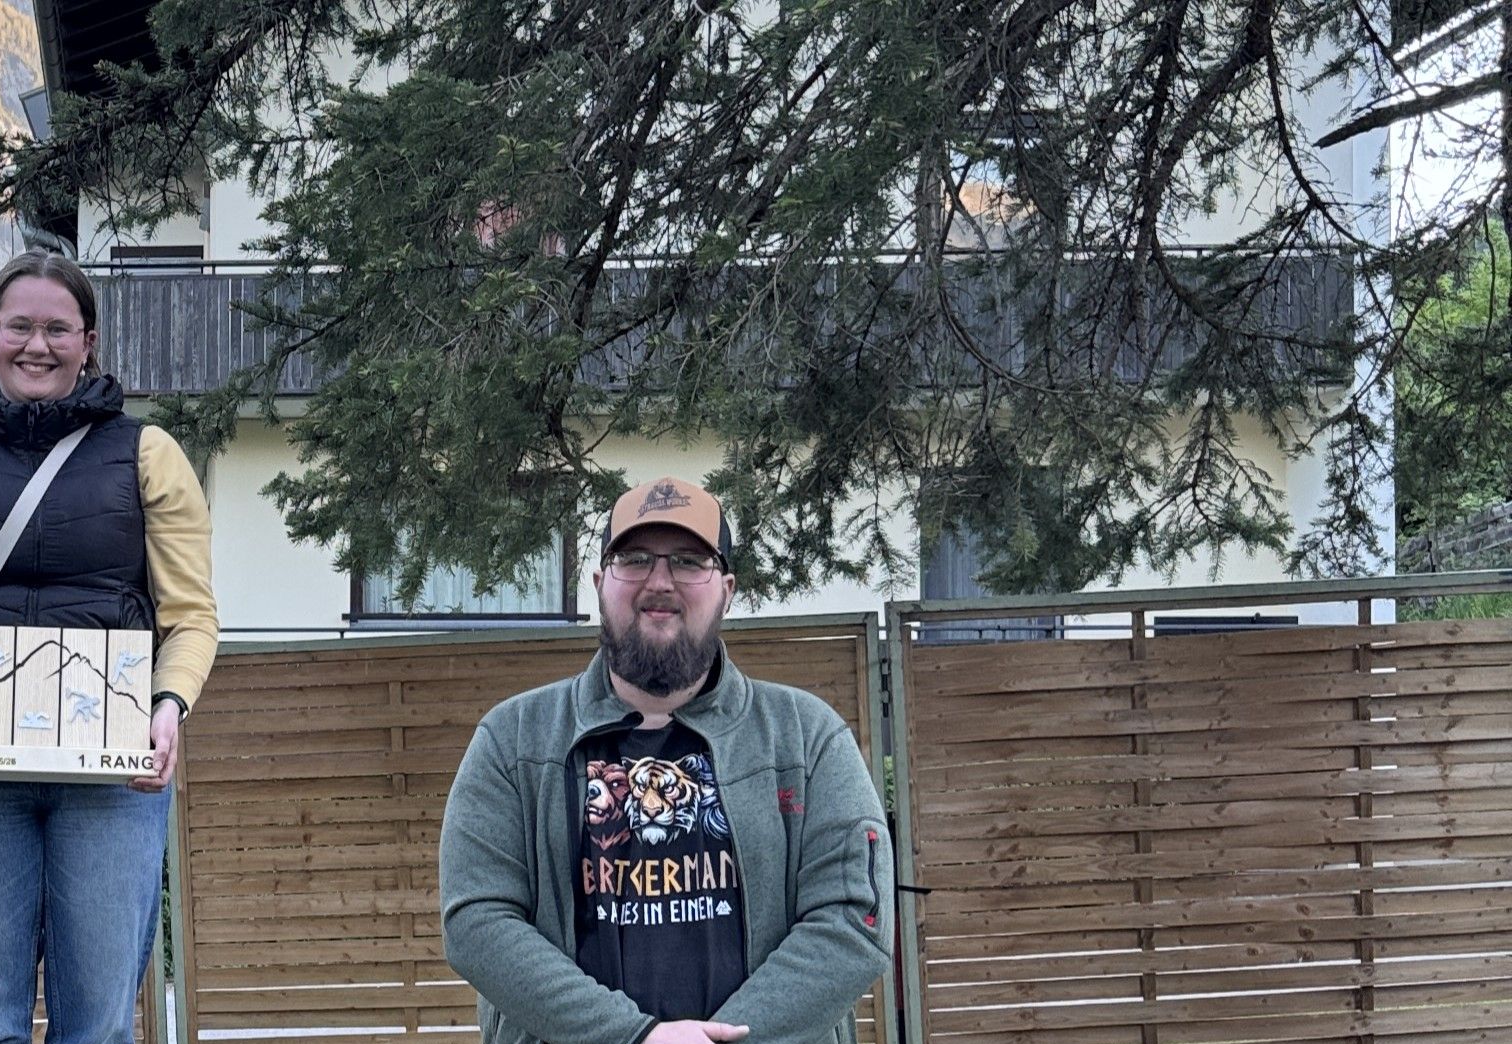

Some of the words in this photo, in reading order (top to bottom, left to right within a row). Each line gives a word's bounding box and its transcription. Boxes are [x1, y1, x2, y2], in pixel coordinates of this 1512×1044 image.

[78, 753, 92, 769] 1.
[100, 754, 154, 770] RANG
[644, 901, 663, 925] IN
